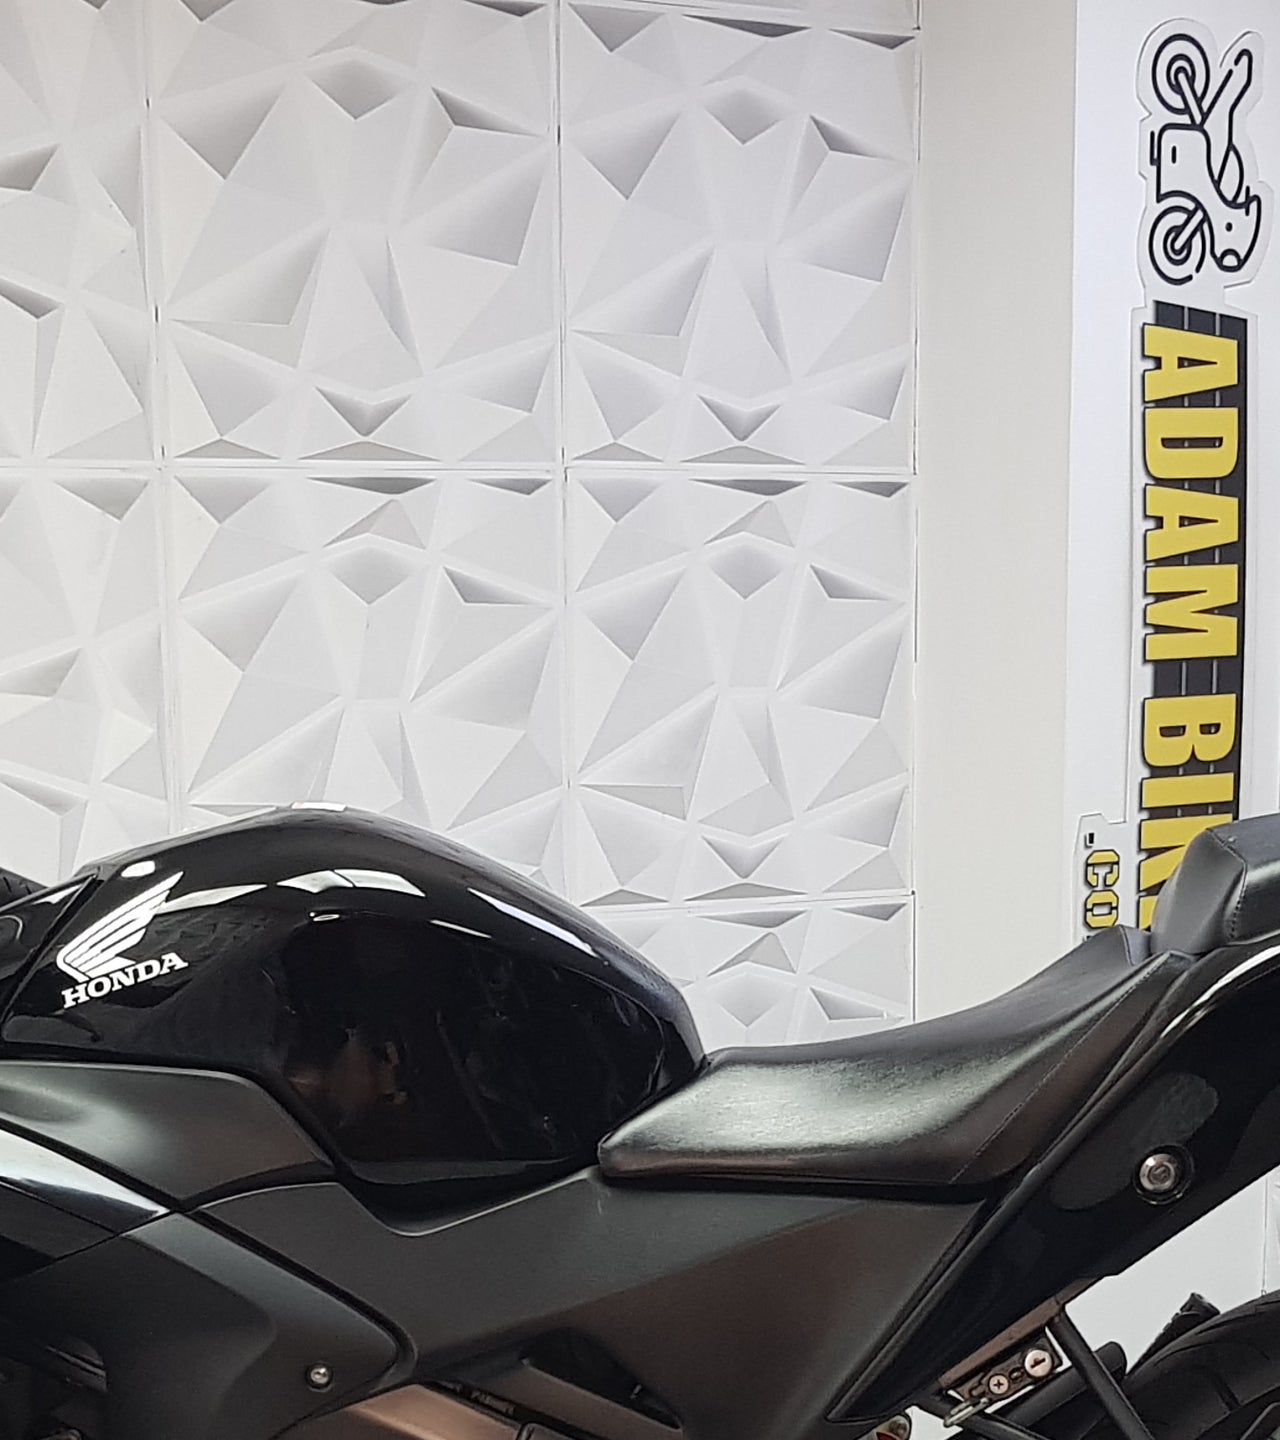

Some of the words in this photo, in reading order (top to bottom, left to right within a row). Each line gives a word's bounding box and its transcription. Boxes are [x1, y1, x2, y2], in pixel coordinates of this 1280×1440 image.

[1142, 322, 1240, 662] ADAM
[1083, 832, 1120, 941] .CO
[1138, 692, 1238, 931] BIK
[61, 952, 189, 1009] HONDA
